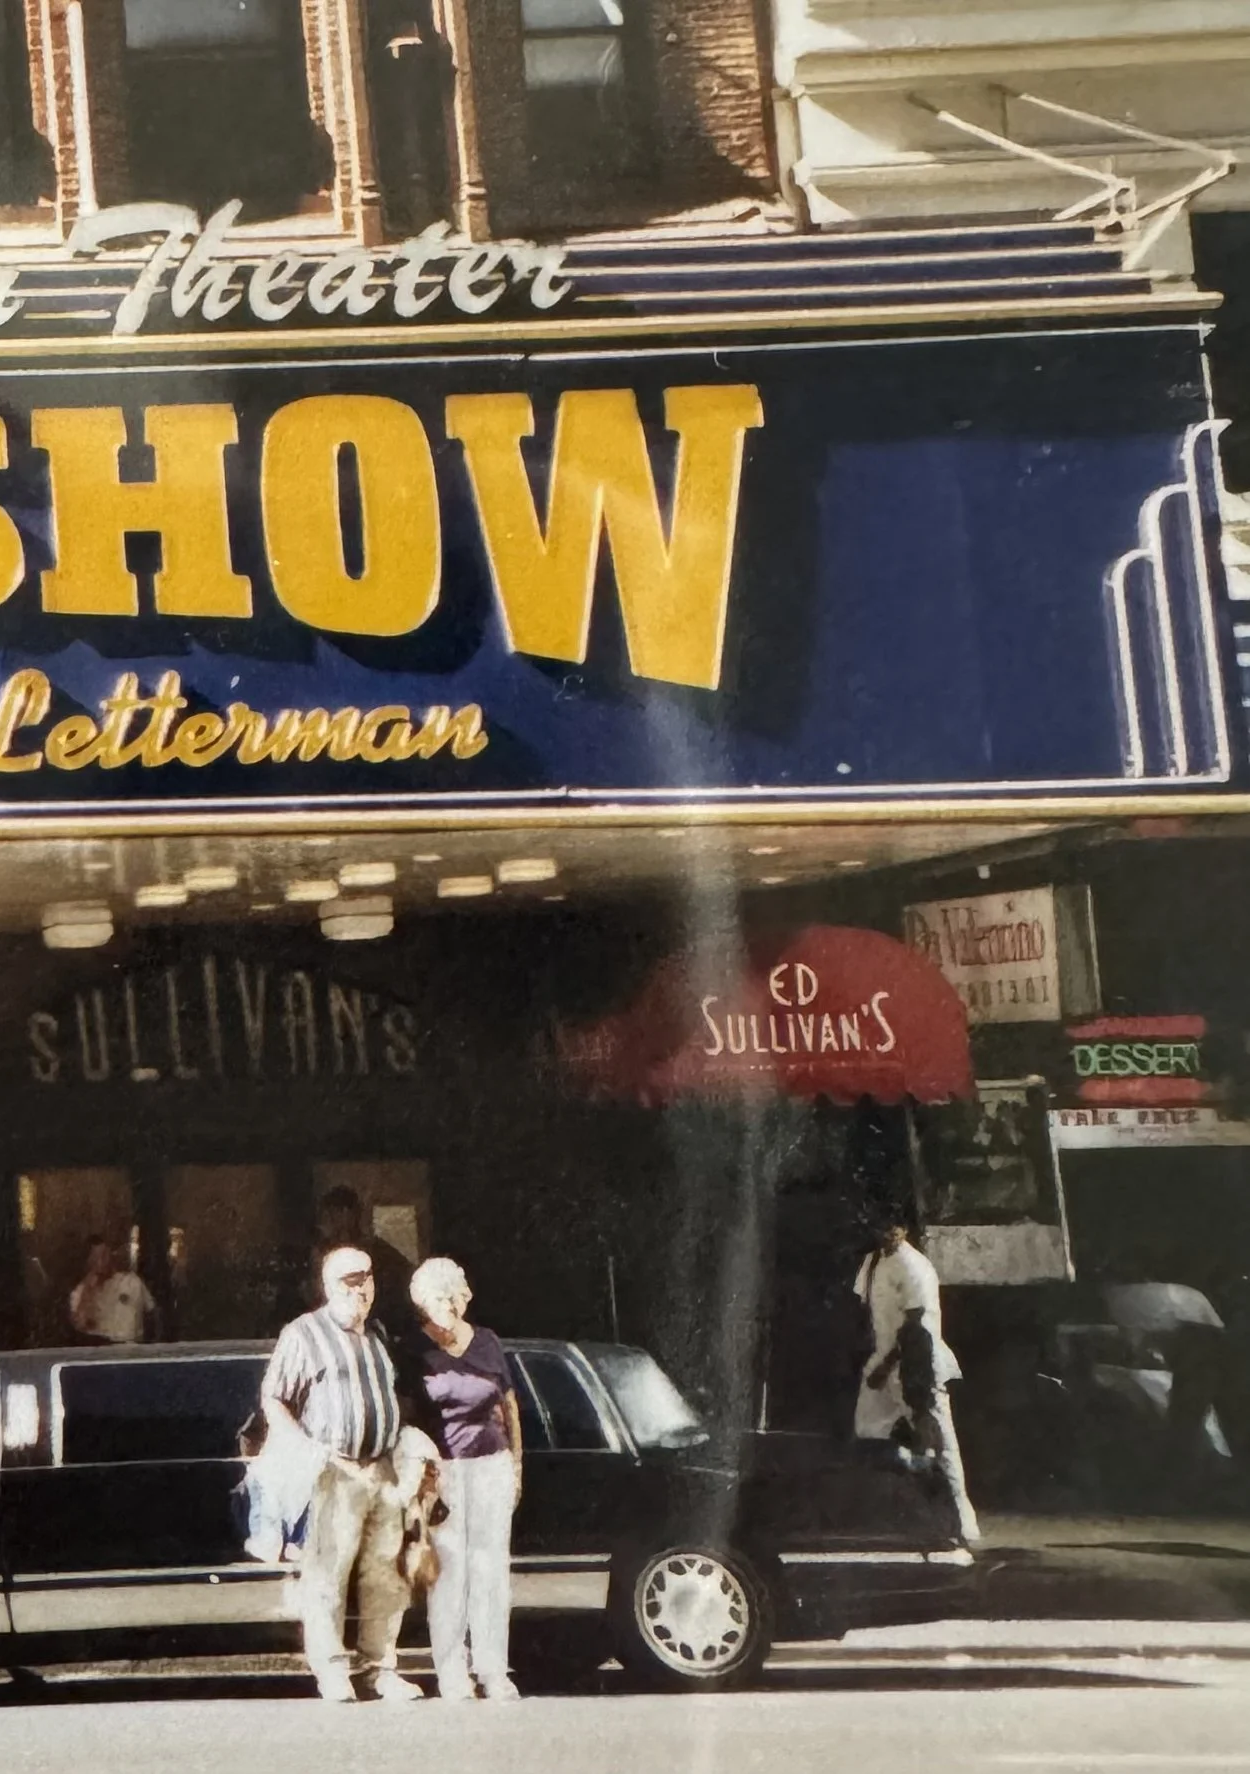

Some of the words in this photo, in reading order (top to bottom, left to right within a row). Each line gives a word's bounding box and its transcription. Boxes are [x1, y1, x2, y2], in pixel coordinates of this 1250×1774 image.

[67, 197, 574, 336] Theater
[769, 962, 819, 1007] ED
[701, 991, 897, 1057] SULLIVAN'S
